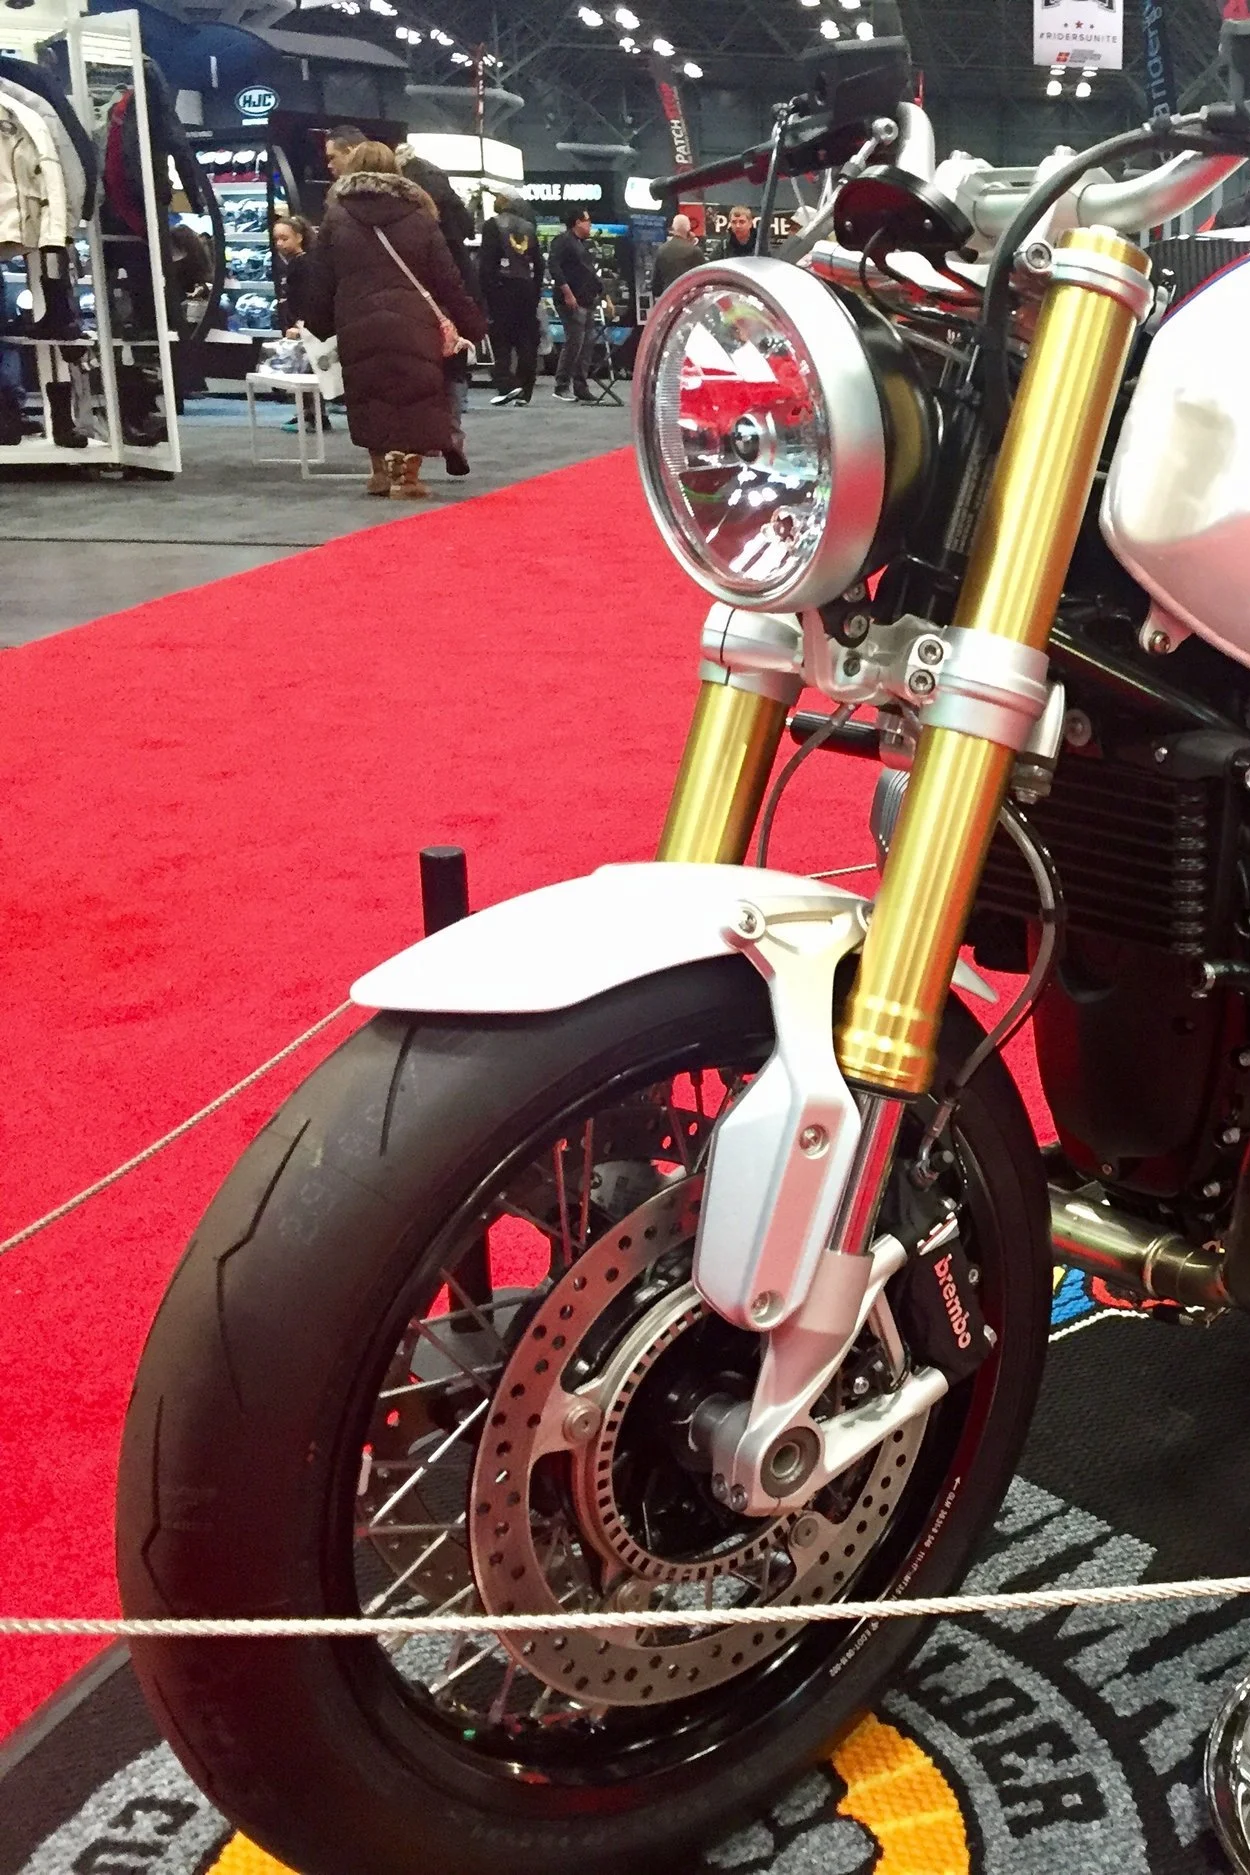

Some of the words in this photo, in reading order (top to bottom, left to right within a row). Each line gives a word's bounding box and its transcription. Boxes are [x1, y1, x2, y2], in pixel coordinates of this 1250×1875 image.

[1039, 31, 1118, 44] #RIDERSUNITE
[242, 94, 273, 108] HJC
[669, 119, 688, 164] PATCH
[933, 1253, 972, 1349] brembo
